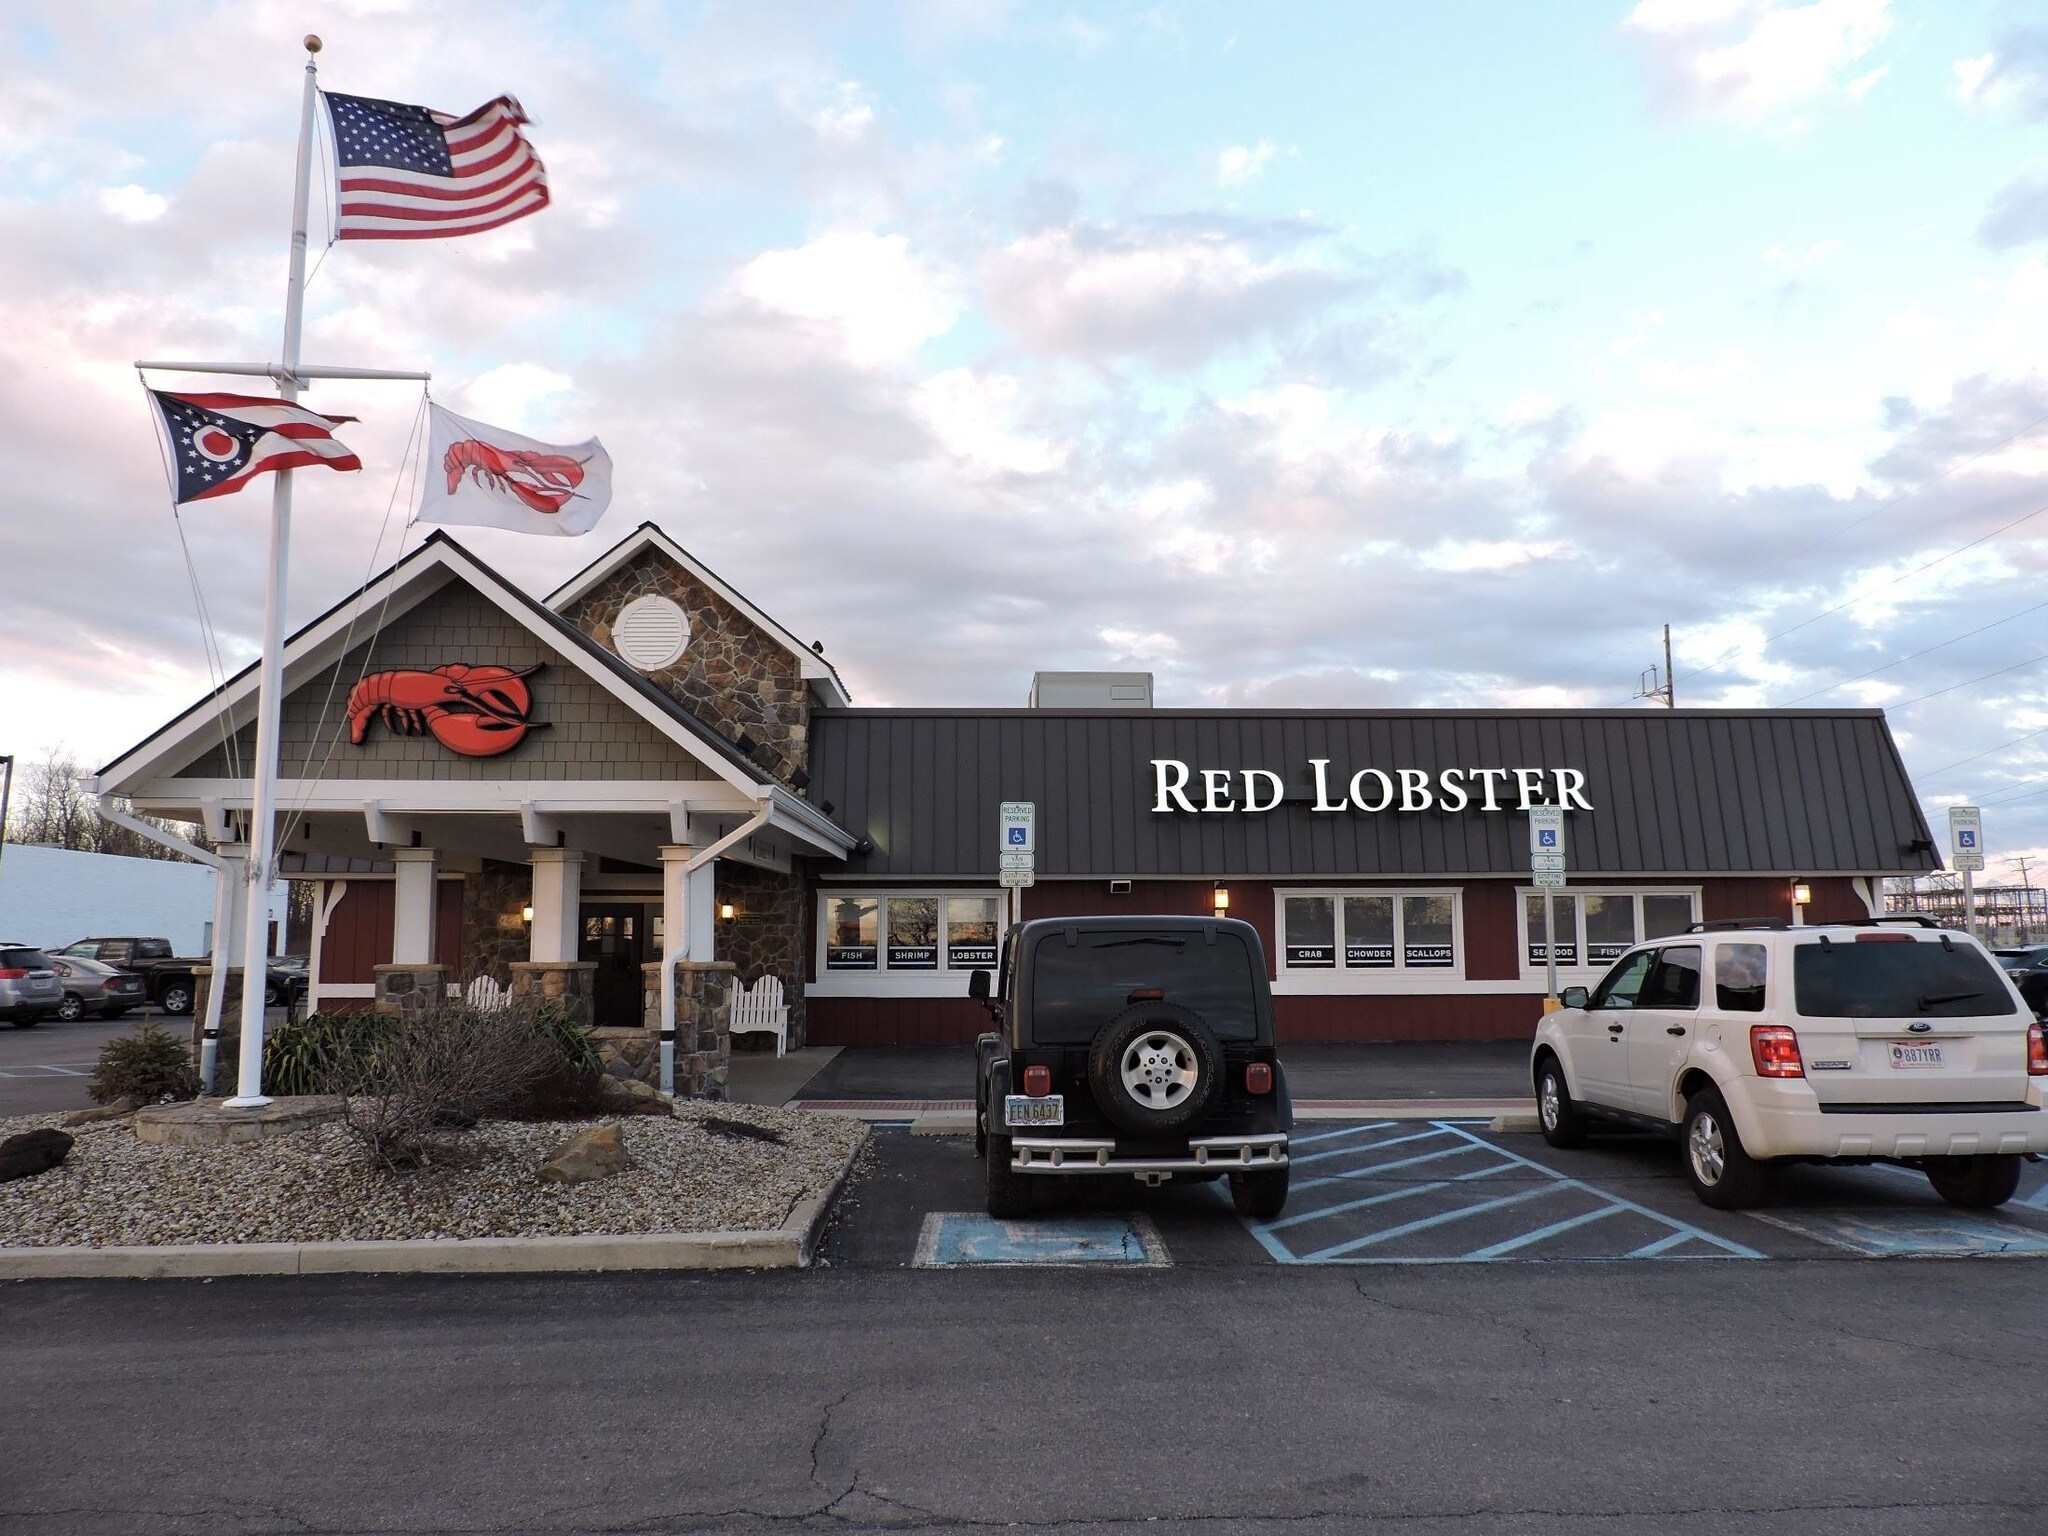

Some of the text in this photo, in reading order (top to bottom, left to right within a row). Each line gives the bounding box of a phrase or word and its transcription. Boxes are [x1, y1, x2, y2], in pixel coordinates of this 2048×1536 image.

[1150, 759, 1595, 813] RED LOBSTER
[1298, 950, 1323, 958] CRAB
[1347, 950, 1392, 958] CHOWDER
[1406, 949, 1452, 957] SCALLOPS
[1532, 948, 1574, 956] SEAOOD
